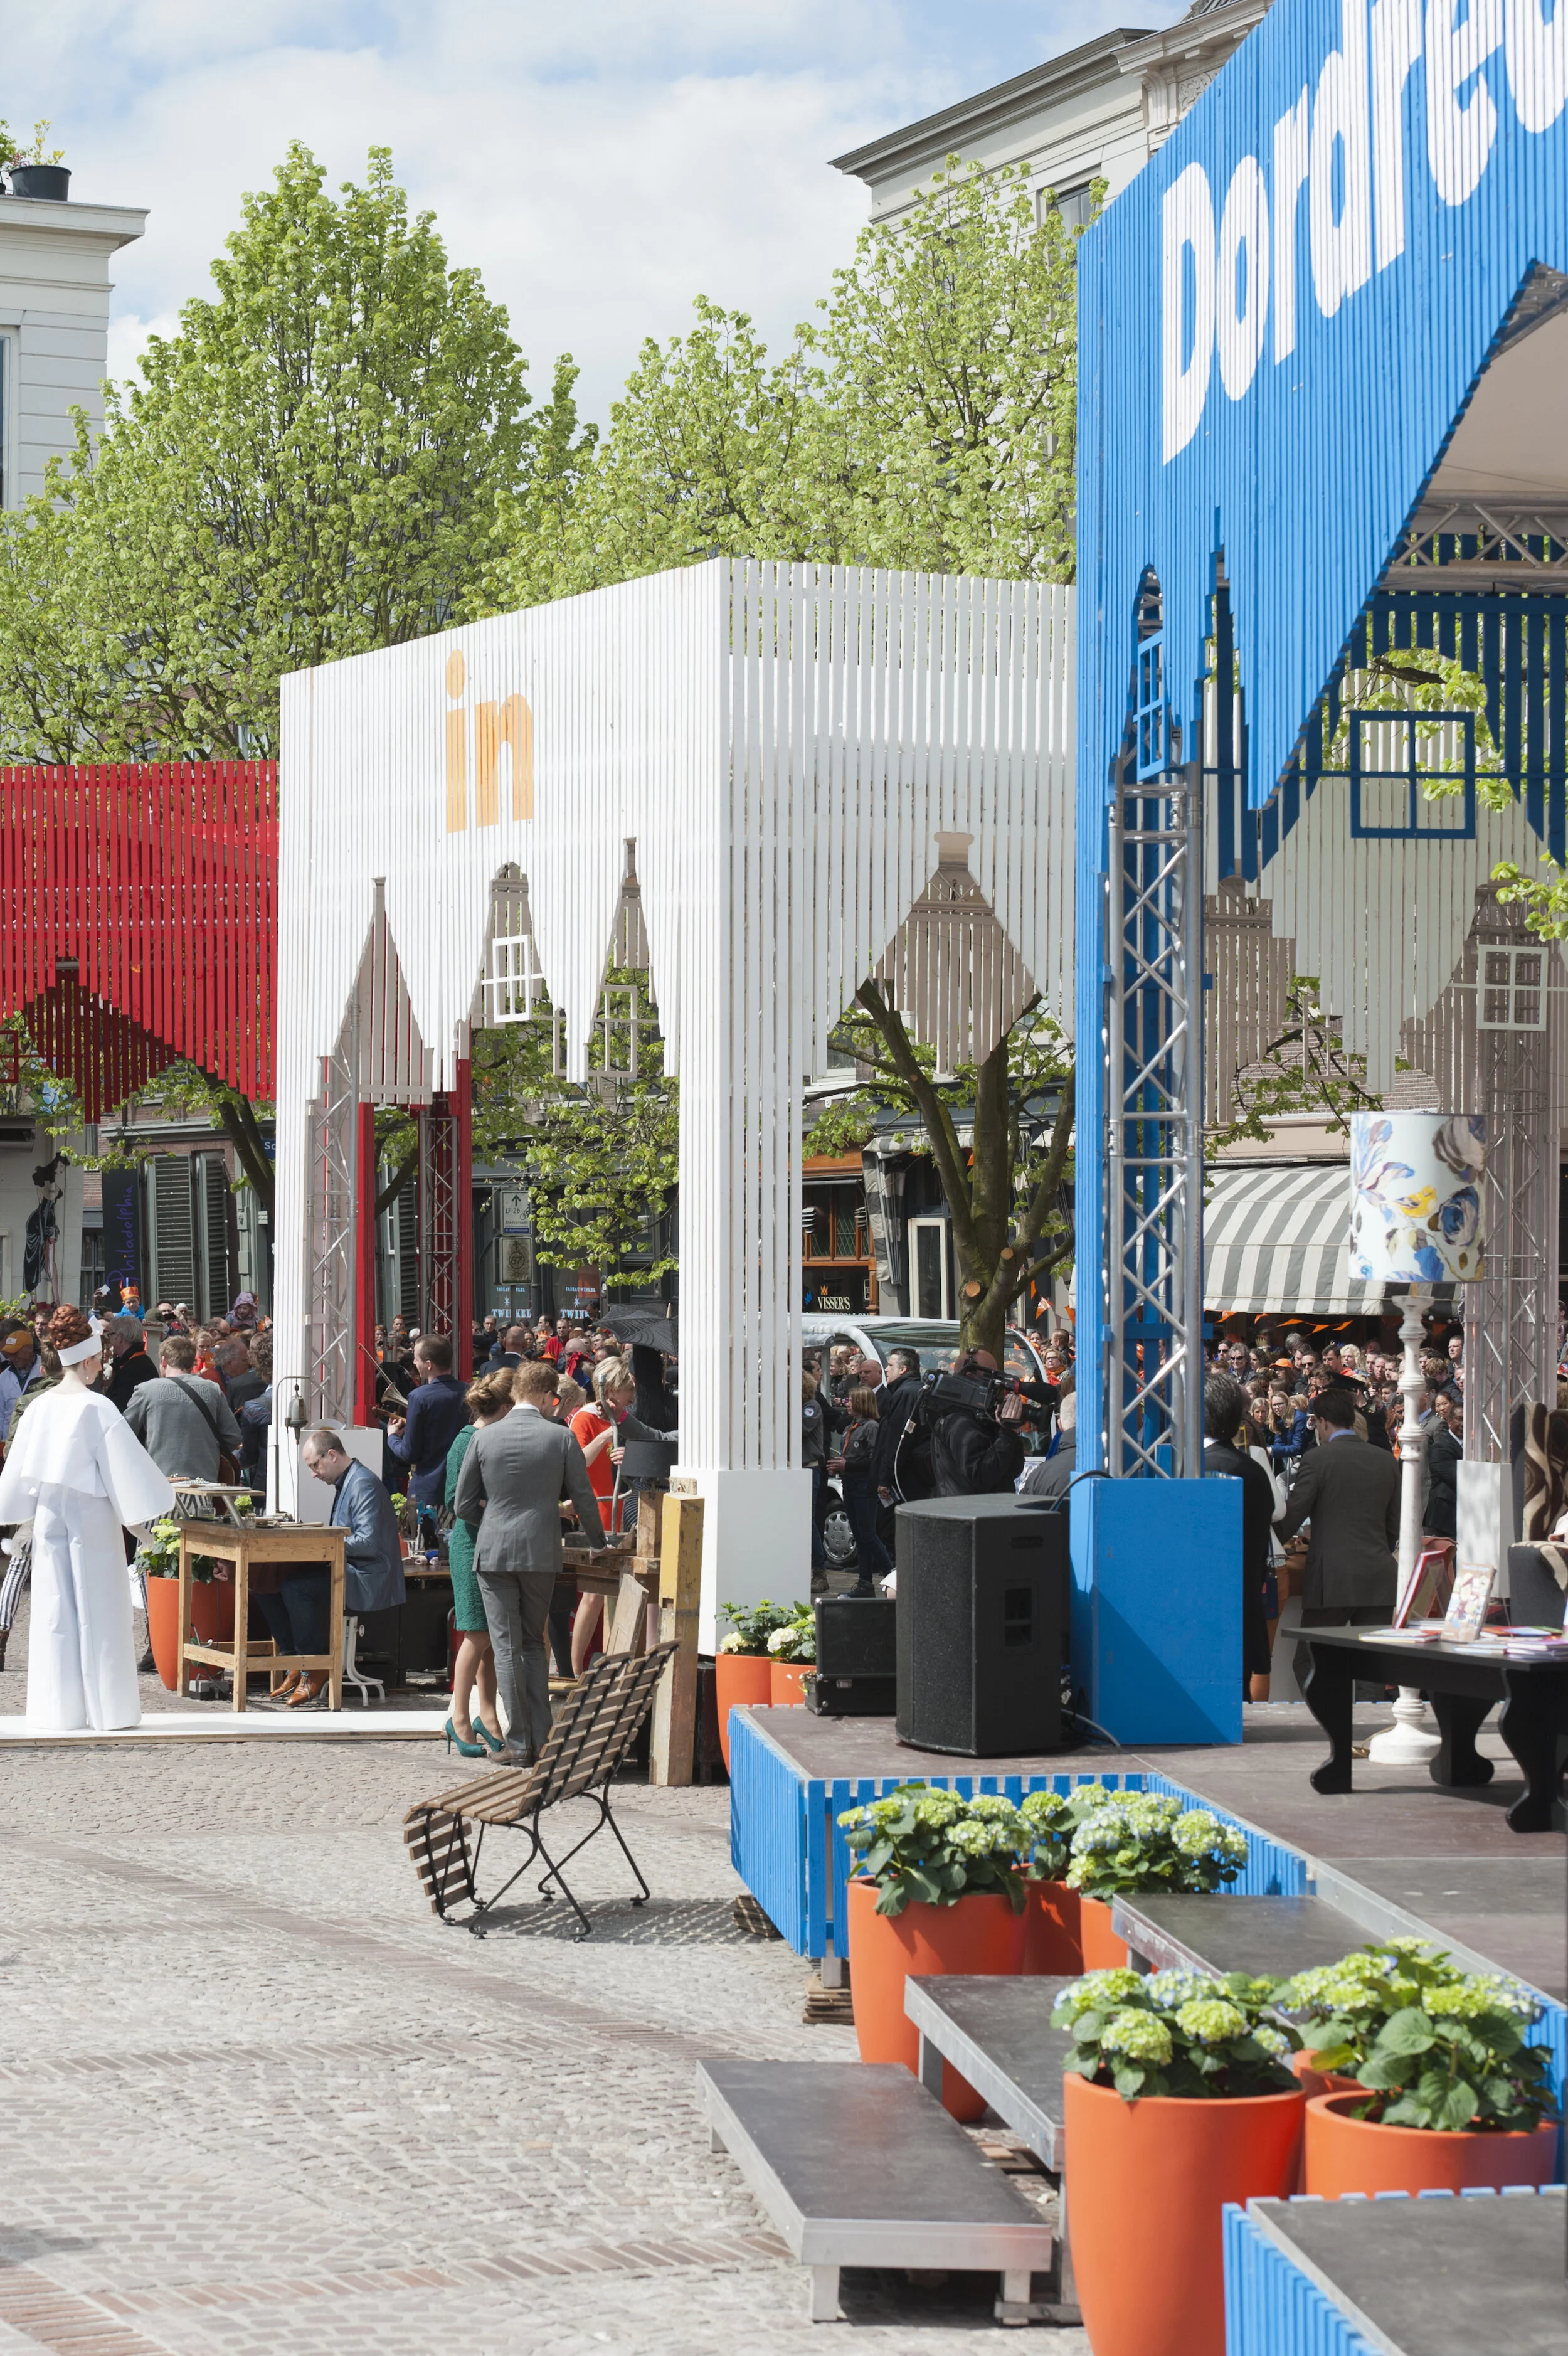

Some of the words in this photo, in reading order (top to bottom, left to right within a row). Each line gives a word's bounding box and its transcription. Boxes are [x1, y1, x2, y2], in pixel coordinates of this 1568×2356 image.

[446, 649, 533, 833] in
[107, 1184, 140, 1295] Philadelphia
[492, 1309, 532, 1318] TWIKEL
[817, 1296, 850, 1310] VISSER'S
